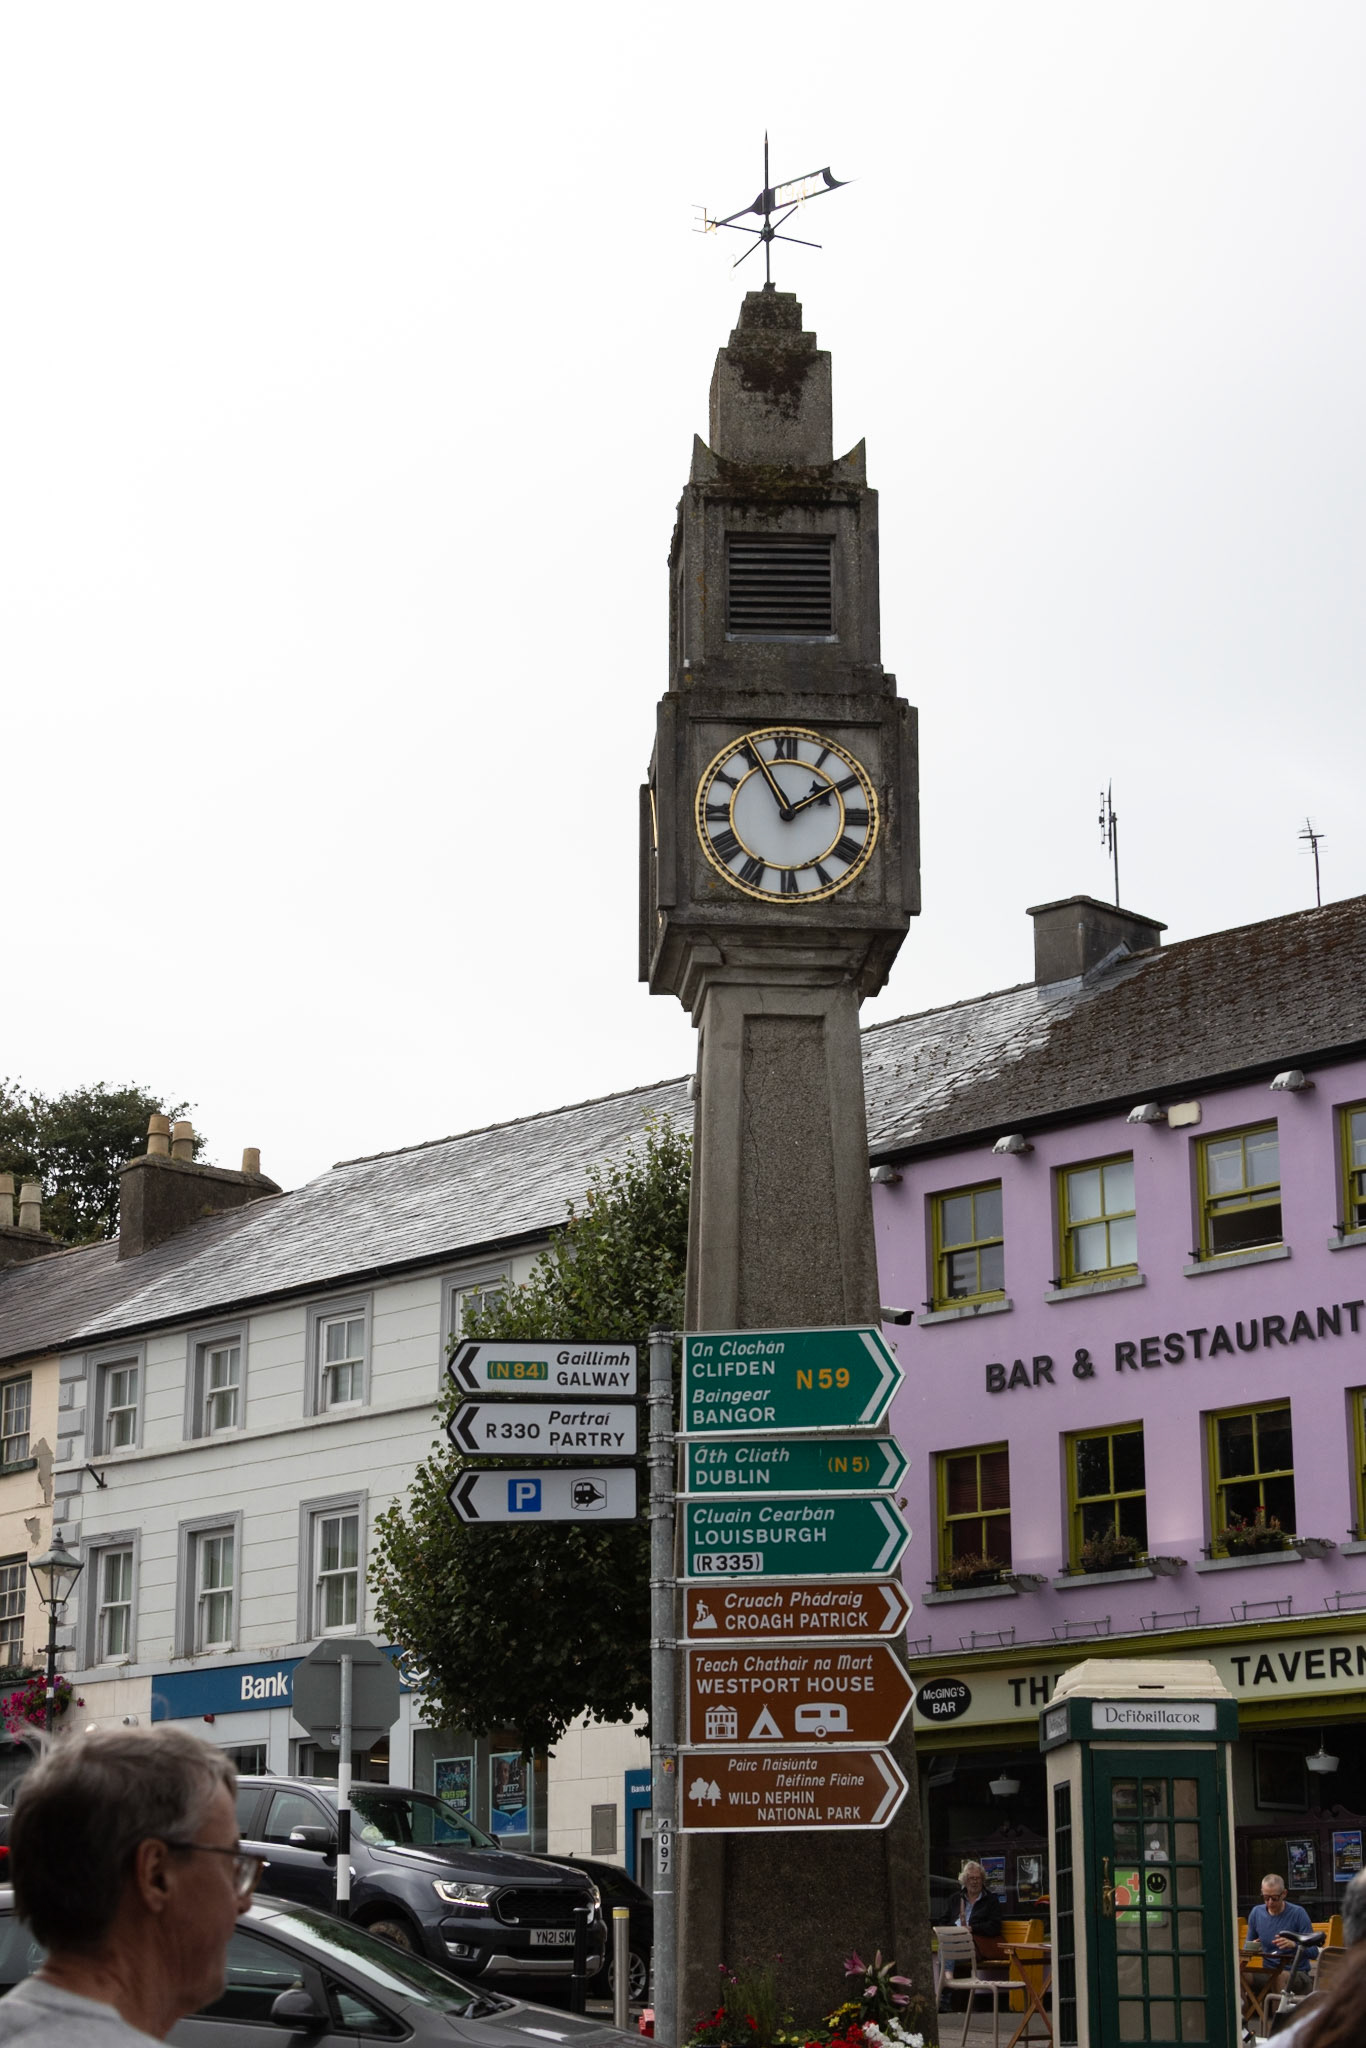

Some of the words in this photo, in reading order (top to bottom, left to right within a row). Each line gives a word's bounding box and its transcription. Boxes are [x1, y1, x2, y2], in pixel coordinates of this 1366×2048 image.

[774, 739, 798, 760] XII
[845, 807, 869, 825] III
[780, 870, 799, 893] VI
[692, 1343, 713, 1357] An
[720, 1341, 784, 1355] Clochán
[985, 1354, 1055, 1393] BAR
[1072, 1348, 1095, 1379] &
[1115, 1300, 1364, 1371] RESTAURANT
[557, 1351, 629, 1365] Gaillimh
[489, 1362, 547, 1379] (N84)
[693, 1361, 774, 1377] CLIFDEN
[557, 1372, 629, 1386] GALWAY
[798, 1368, 849, 1389] N59
[693, 1389, 770, 1404] Baingear
[549, 1411, 609, 1425] Partraí
[694, 1407, 775, 1424] BANGOR
[487, 1423, 540, 1438] R330
[550, 1432, 624, 1446] PARTRY
[695, 1449, 727, 1463] Áth
[735, 1448, 789, 1462] Cliath
[696, 1470, 769, 1484] DUBLIN
[517, 1483, 536, 1509] P
[694, 1509, 751, 1523] Cluain
[759, 1507, 834, 1521] Cearbán
[695, 1528, 826, 1544] LOUISBURGH
[696, 1554, 760, 1572] (R335)
[725, 1593, 782, 1608] Cruach
[790, 1592, 862, 1608] Phádraig
[726, 1614, 793, 1629] CROAGH
[801, 1612, 868, 1627] PATRICK
[696, 1657, 737, 1672] Teach
[744, 1656, 808, 1671] Chathair
[814, 1659, 831, 1669] na
[838, 1655, 872, 1669] Mart
[241, 1671, 288, 1700] Bank
[697, 1678, 800, 1693] WESTPORT
[808, 1677, 874, 1691] HOUSE
[923, 1686, 965, 1701] McGING'S
[932, 1702, 956, 1714] BAR
[1105, 1706, 1201, 1724] Defibrillator
[728, 1759, 757, 1771] Páirc
[763, 1758, 817, 1770] Náisiúnta
[776, 1774, 825, 1786] Néifinne
[830, 1774, 864, 1785] Fiáine
[631, 1785, 645, 1793] Bank
[729, 1792, 760, 1804] WILD
[766, 1792, 813, 1803] NEPHIN
[758, 1808, 822, 1820] NATIONAL
[828, 1807, 860, 1819] PARK
